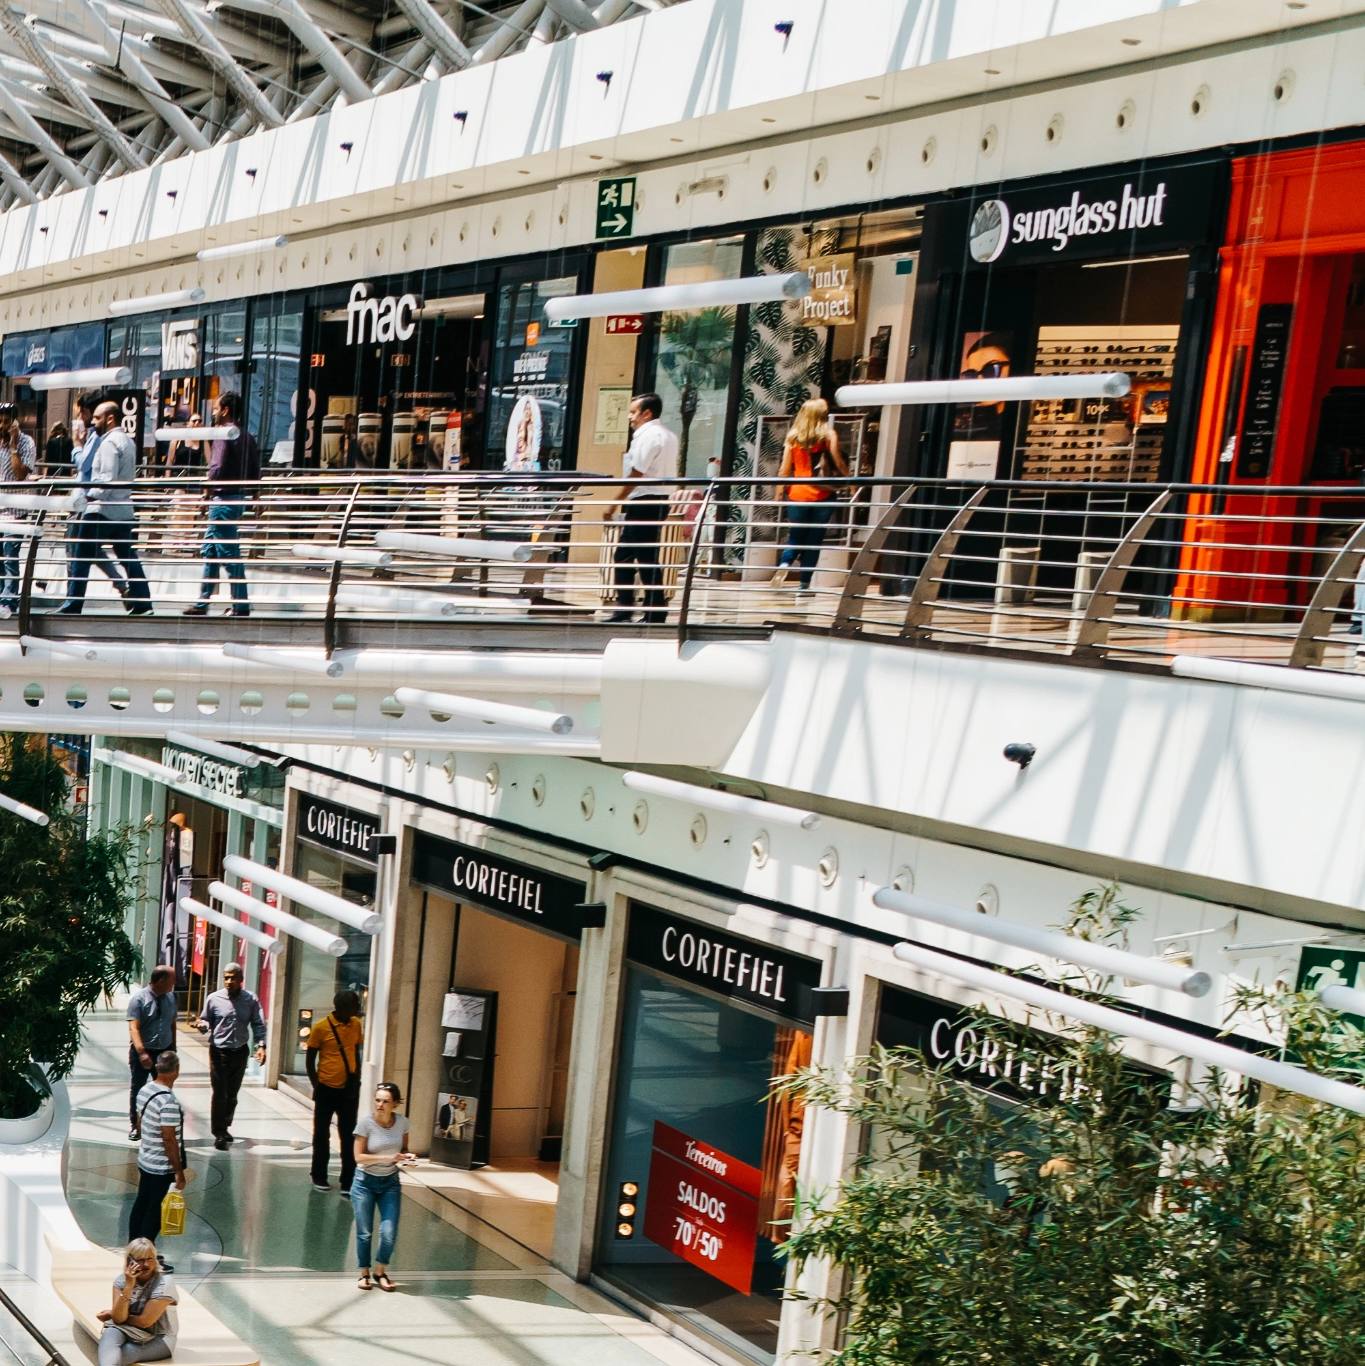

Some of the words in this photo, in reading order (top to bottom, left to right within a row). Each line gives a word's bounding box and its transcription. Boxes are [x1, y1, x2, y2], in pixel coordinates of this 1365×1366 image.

[1012, 191, 1117, 251] sunglass
[1118, 183, 1167, 230] hut
[808, 264, 849, 290] Funky
[346, 282, 417, 345] fnac
[803, 293, 850, 320] Project
[27, 343, 46, 367] asics
[161, 319, 200, 371] VANS
[307, 805, 378, 852] CORTEFIE
[453, 856, 543, 914] CORTEFIEL
[662, 927, 786, 1002] CORTEFIEL
[685, 1141, 727, 1176] Terceiros
[677, 1181, 727, 1223] SALDOS
